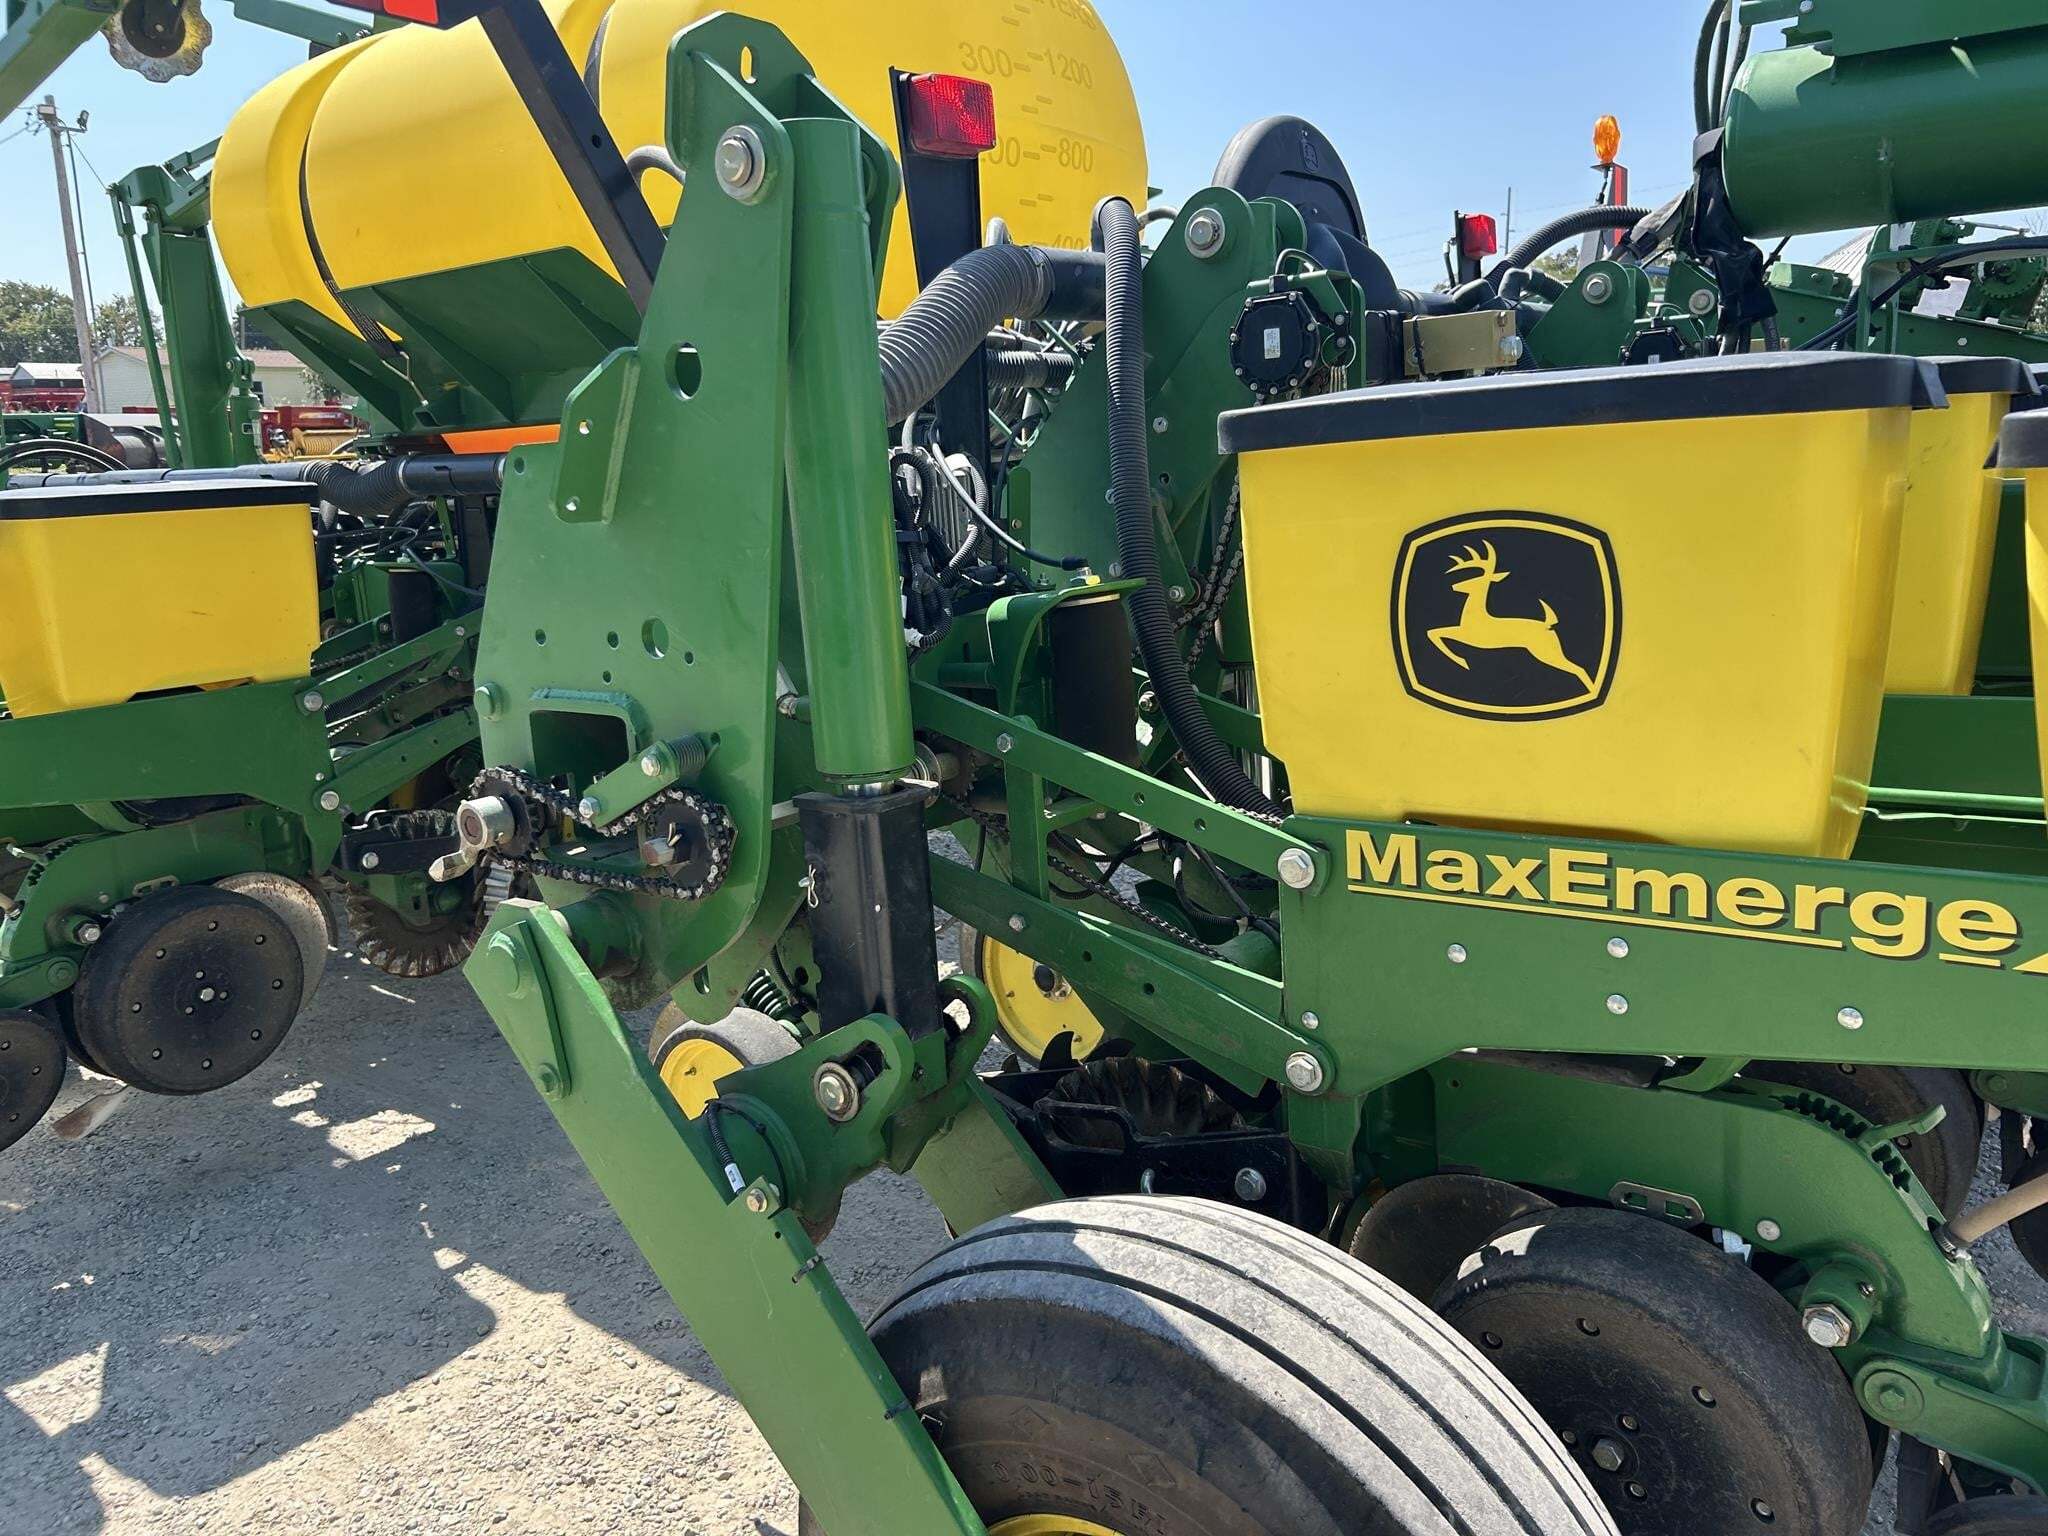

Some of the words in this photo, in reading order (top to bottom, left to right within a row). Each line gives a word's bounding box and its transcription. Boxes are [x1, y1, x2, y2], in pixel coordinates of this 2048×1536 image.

[958, 41, 1014, 78] 300
[1044, 48, 1093, 89] 1200
[981, 135, 1021, 168] 00
[1058, 138, 1094, 173] 800
[1345, 829, 2018, 957] MaxEmerge
